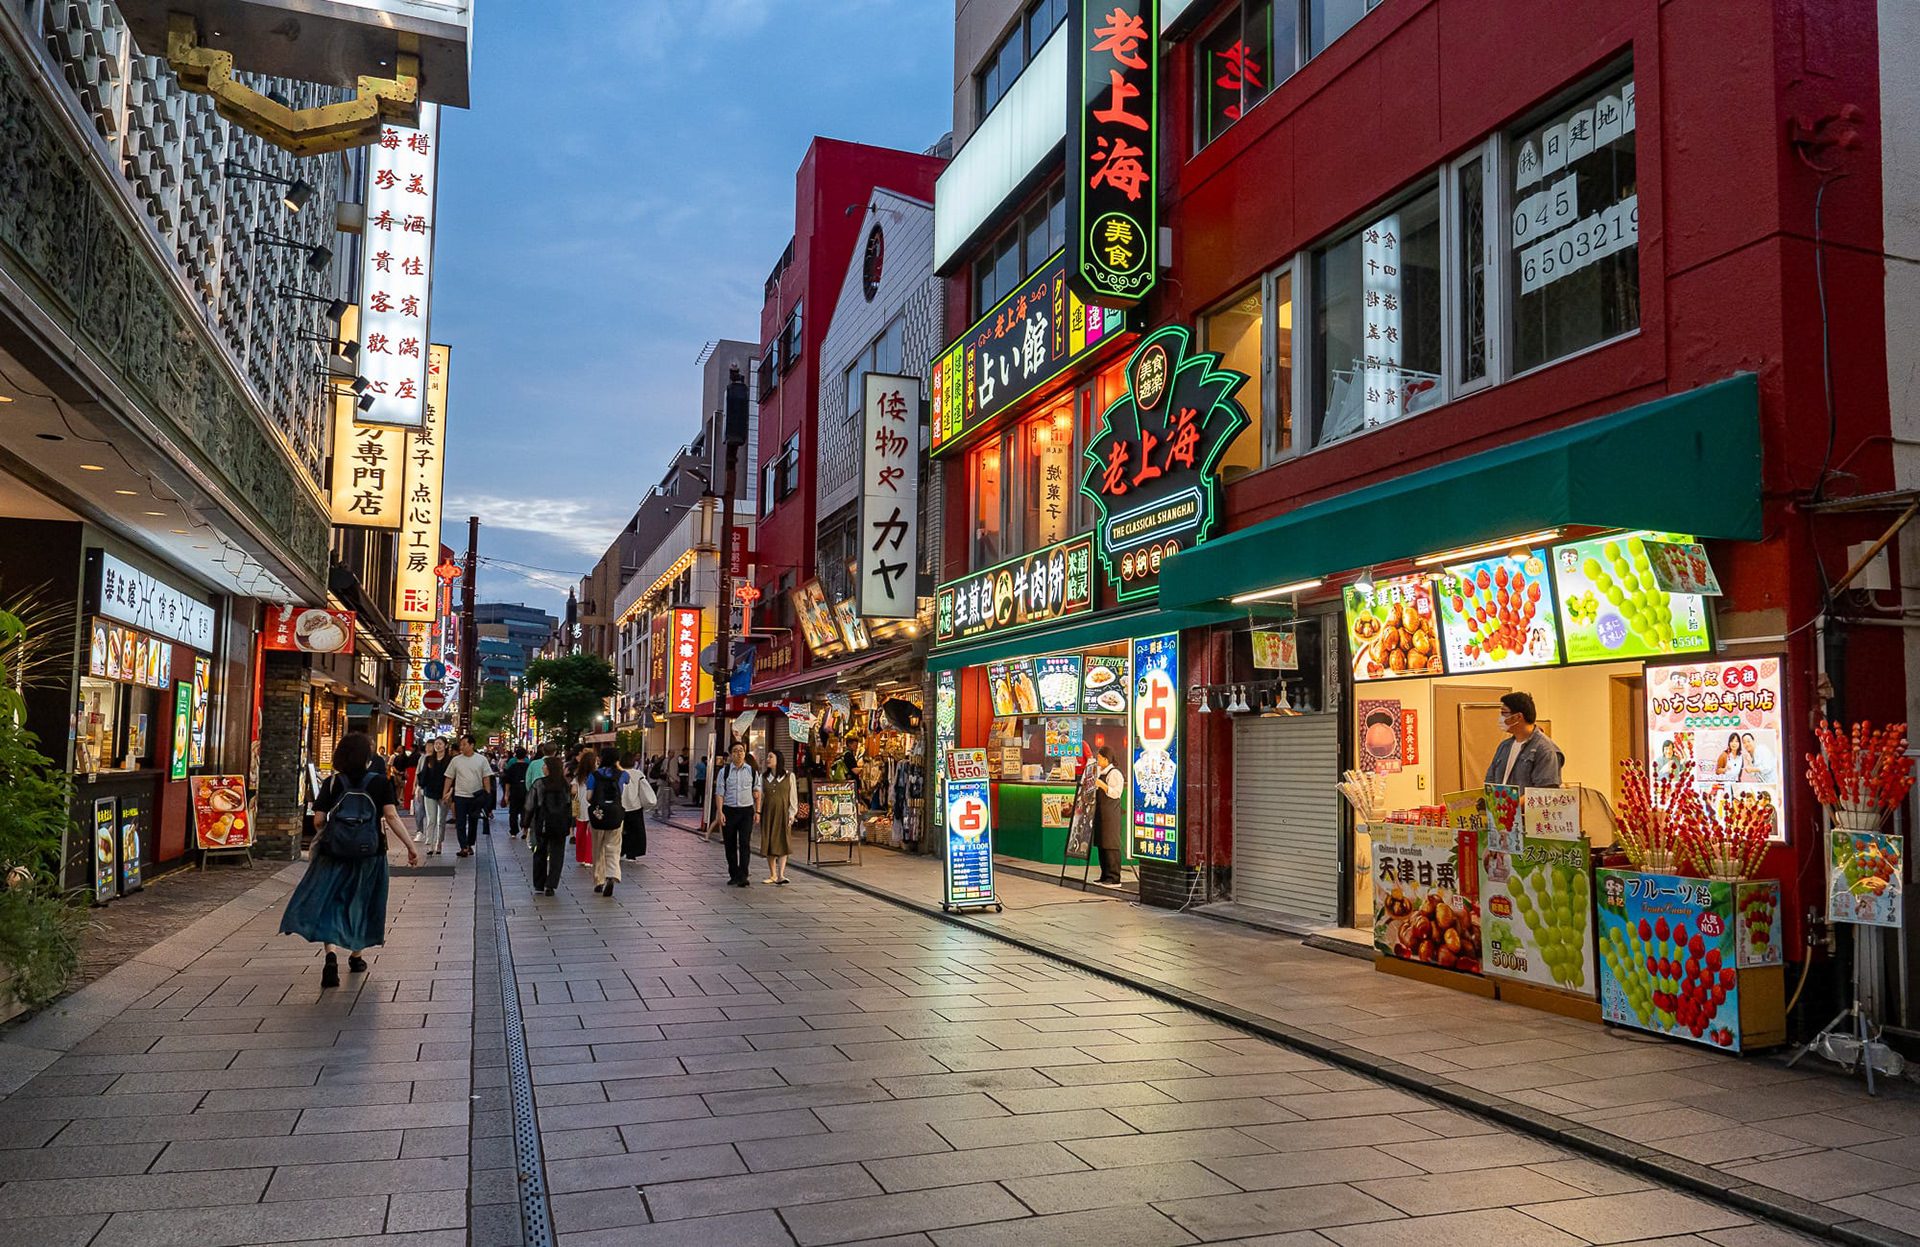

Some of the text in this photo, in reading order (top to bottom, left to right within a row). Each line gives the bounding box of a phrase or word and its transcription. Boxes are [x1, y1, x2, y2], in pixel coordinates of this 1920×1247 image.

[1090, 8, 1150, 202] 老上海
[1514, 190, 1570, 236] 045
[1104, 219, 1133, 269] 美食
[994, 295, 1028, 339] 老上海
[978, 311, 1049, 409] 占い館
[1102, 407, 1200, 496] 老上海
[1112, 500, 1195, 540] THE CLASSICAL SHANGHAI
[1088, 657, 1125, 667] DIM SUM
[1726, 669, 1756, 685] 元祖
[1144, 678, 1168, 740] 占
[1652, 689, 1776, 715] いちご飴専門店
[959, 800, 981, 830] 占
[1379, 856, 1456, 890] 天津甘栗
[1627, 879, 1712, 907] フルーツ飴
[1700, 924, 1720, 935] NO.1
[1491, 949, 1528, 974] 500円
